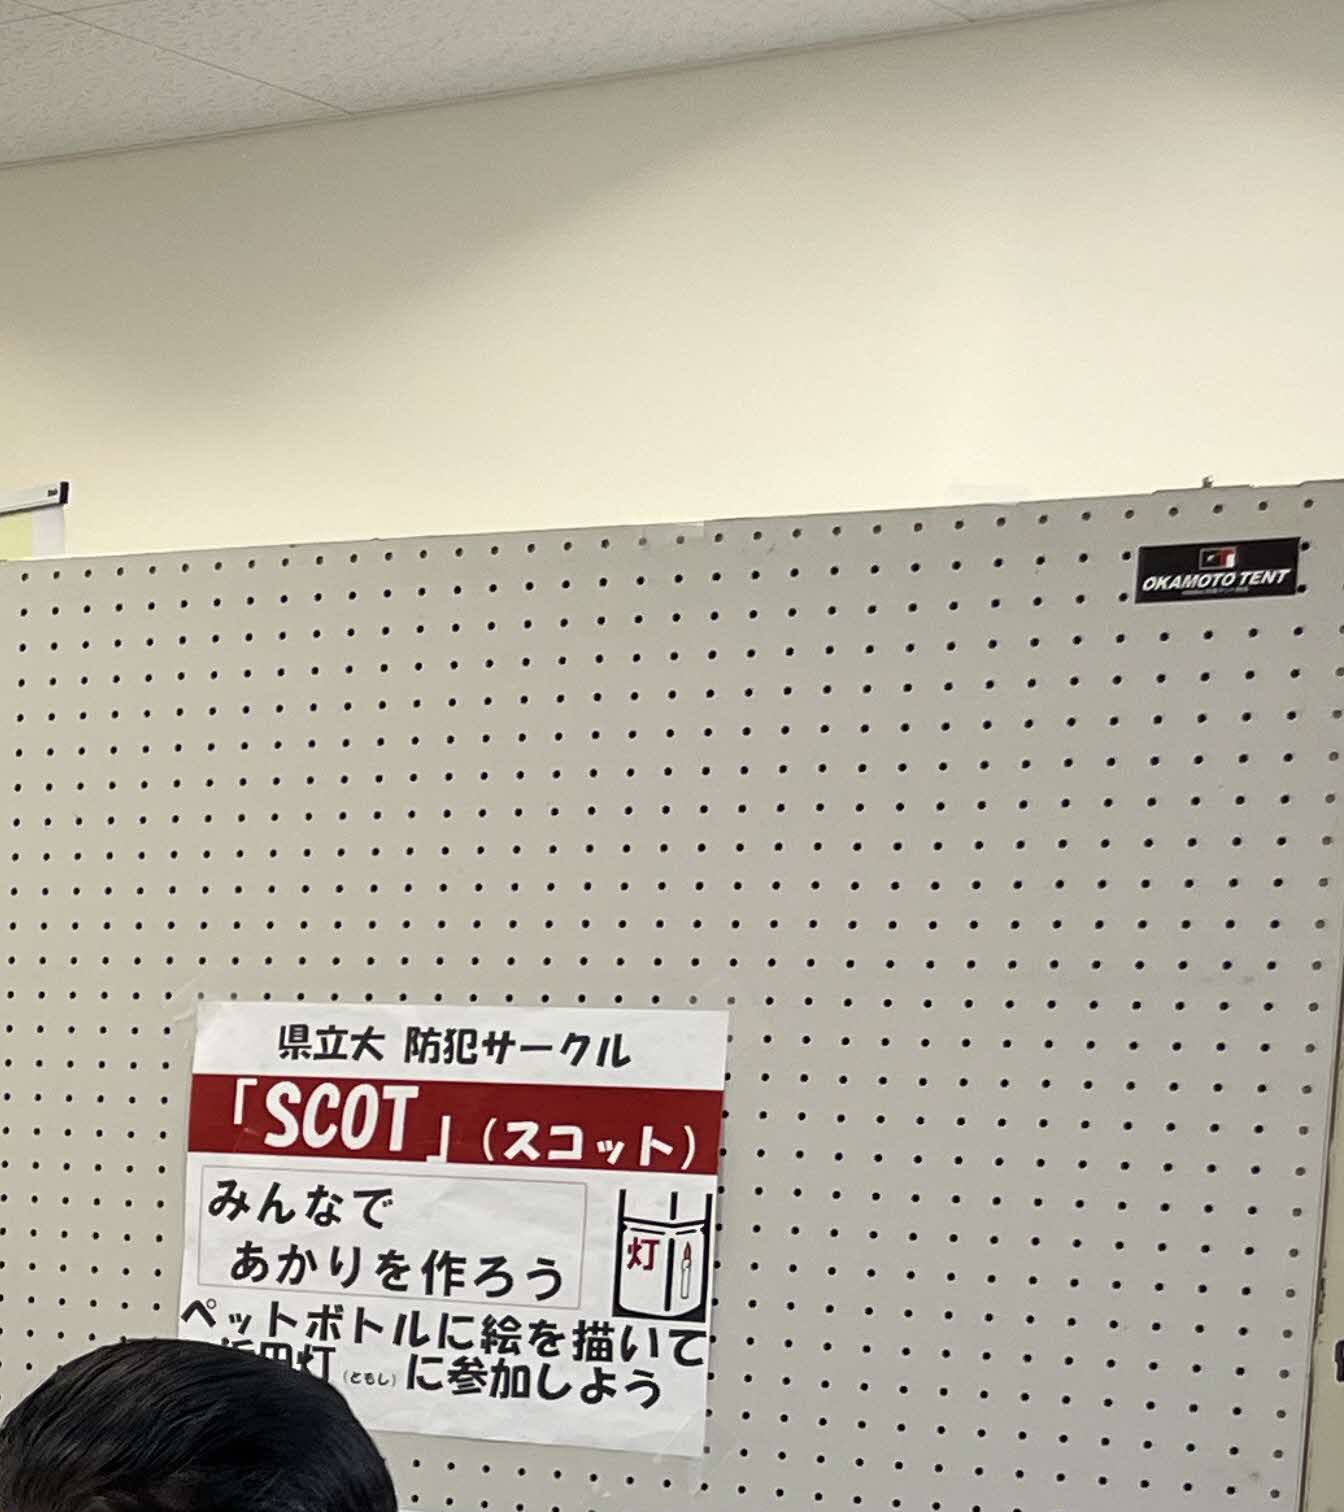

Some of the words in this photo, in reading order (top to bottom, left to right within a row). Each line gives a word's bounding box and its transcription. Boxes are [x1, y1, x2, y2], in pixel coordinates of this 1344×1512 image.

[1142, 571, 1235, 592] OKAMOTO
[1240, 568, 1292, 587] TENT
[277, 1023, 386, 1063] 県立大
[403, 1026, 632, 1070] 防犯サークル
[207, 1179, 394, 1230] みんなで
[229, 1240, 565, 1303] あかりを作ろう
[626, 1236, 661, 1273] 灯
[180, 1298, 708, 1369] ペットボトルに絵を描いて
[407, 1353, 662, 1411] に参加しよう
